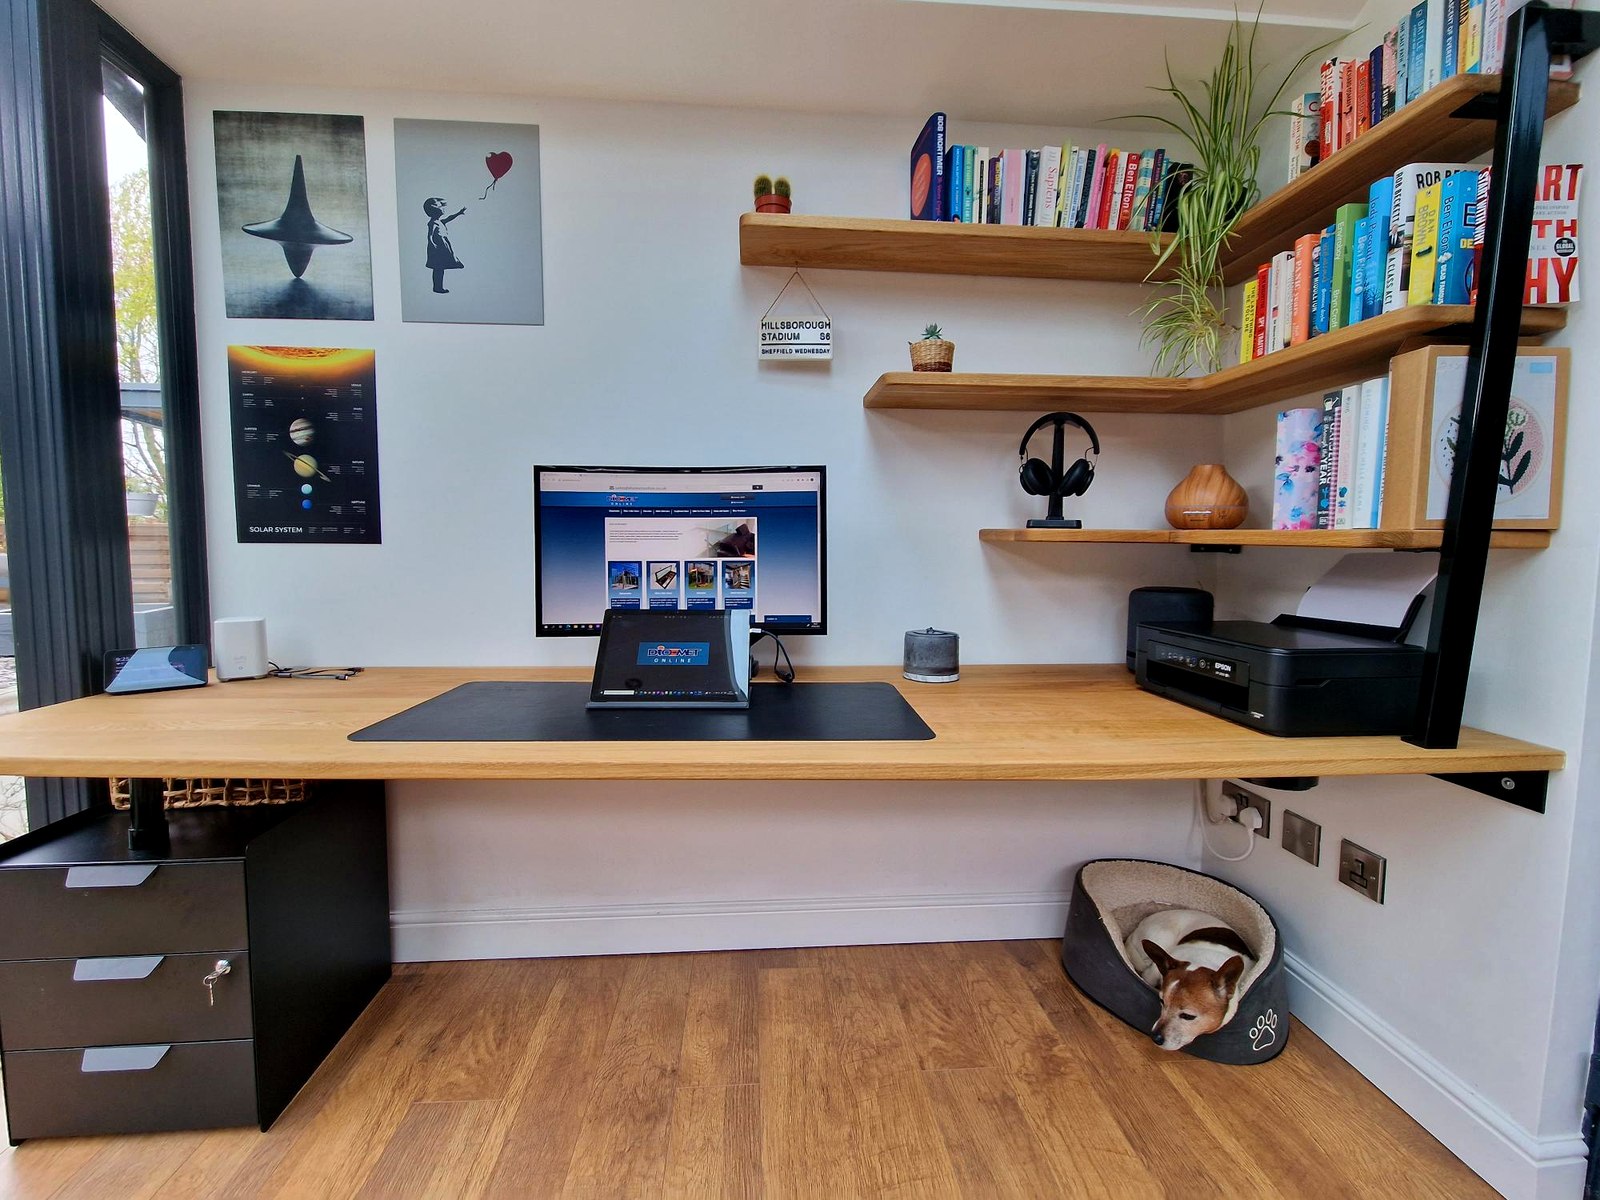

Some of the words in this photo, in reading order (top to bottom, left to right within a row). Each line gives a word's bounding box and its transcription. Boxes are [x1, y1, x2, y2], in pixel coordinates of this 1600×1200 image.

[1416, 20, 1424, 52] BATTLE
[1447, 25, 1453, 35] OF
[1127, 164, 1137, 182] Ben
[1394, 172, 1402, 188] ROB
[1416, 170, 1440, 189] ROB
[1045, 166, 1057, 208] Sapiens
[1122, 184, 1134, 208] Elton
[1477, 171, 1489, 200] START
[1370, 197, 1378, 220] Jodi
[1392, 189, 1400, 223] BECKETT
[1444, 196, 1454, 219] Ben
[1476, 199, 1487, 226] WITH
[1416, 204, 1428, 246] BROWN
[1474, 222, 1486, 245] WHY
[1532, 219, 1577, 238] TH
[1358, 236, 1367, 257] Ben
[1366, 223, 1376, 260] Picoult
[1441, 220, 1452, 254] Elton
[1355, 258, 1365, 287] Elton
[1386, 264, 1395, 288] CLASS
[1525, 257, 1578, 304] HY
[1384, 290, 1393, 305] ACT
[1438, 280, 1446, 304] FAMOUS
[761, 321, 831, 330] HILLSBOROUGH
[761, 332, 800, 341] STADIUM
[820, 332, 831, 341] S6
[1244, 323, 1249, 333] ME
[1319, 456, 1327, 485] YEAR
[1215, 662, 1231, 671] EPSON
